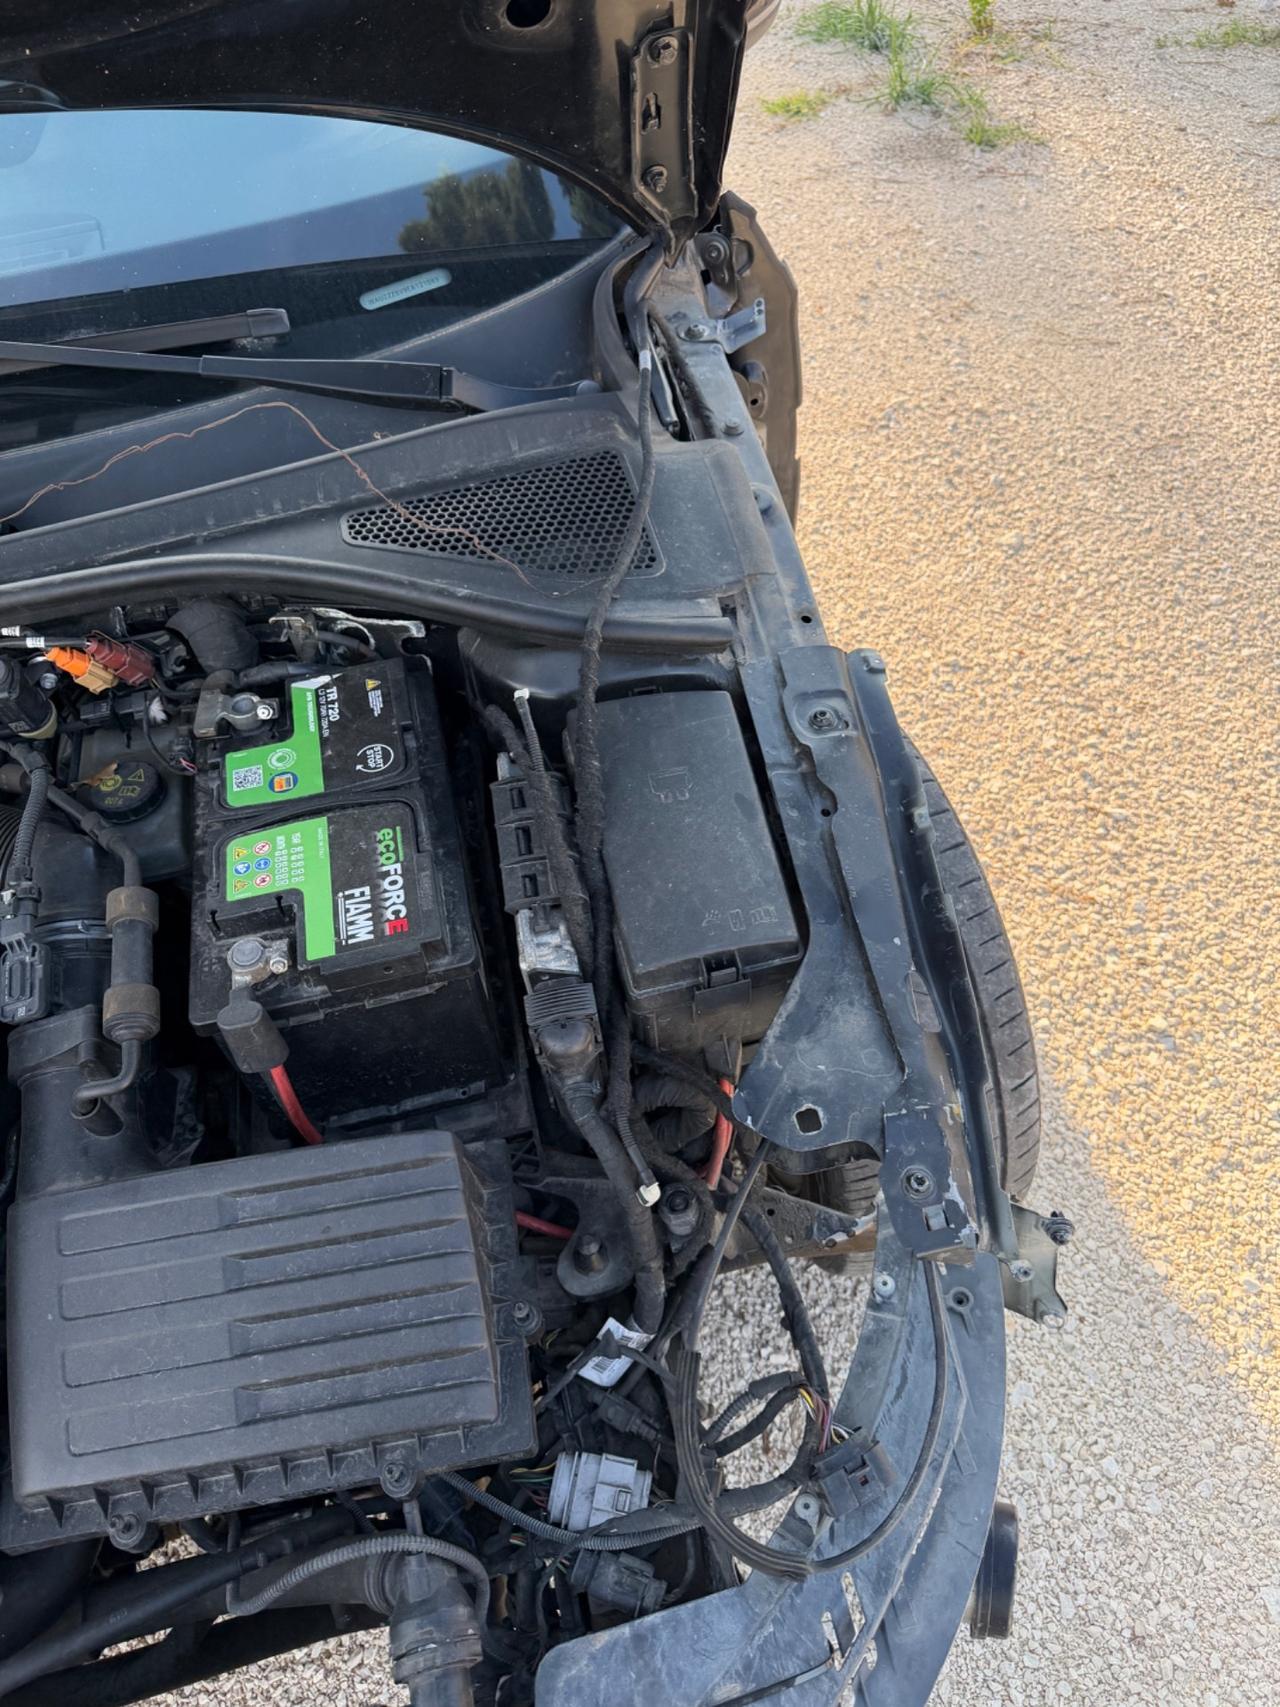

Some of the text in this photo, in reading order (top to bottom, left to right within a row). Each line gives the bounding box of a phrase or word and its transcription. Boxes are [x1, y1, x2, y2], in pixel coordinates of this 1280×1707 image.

[326, 686, 340, 721] TR 720
[366, 749, 375, 768] STOP
[374, 746, 384, 768] START
[379, 828, 408, 936] ecoFORCE
[344, 886, 374, 944] FIAMM
